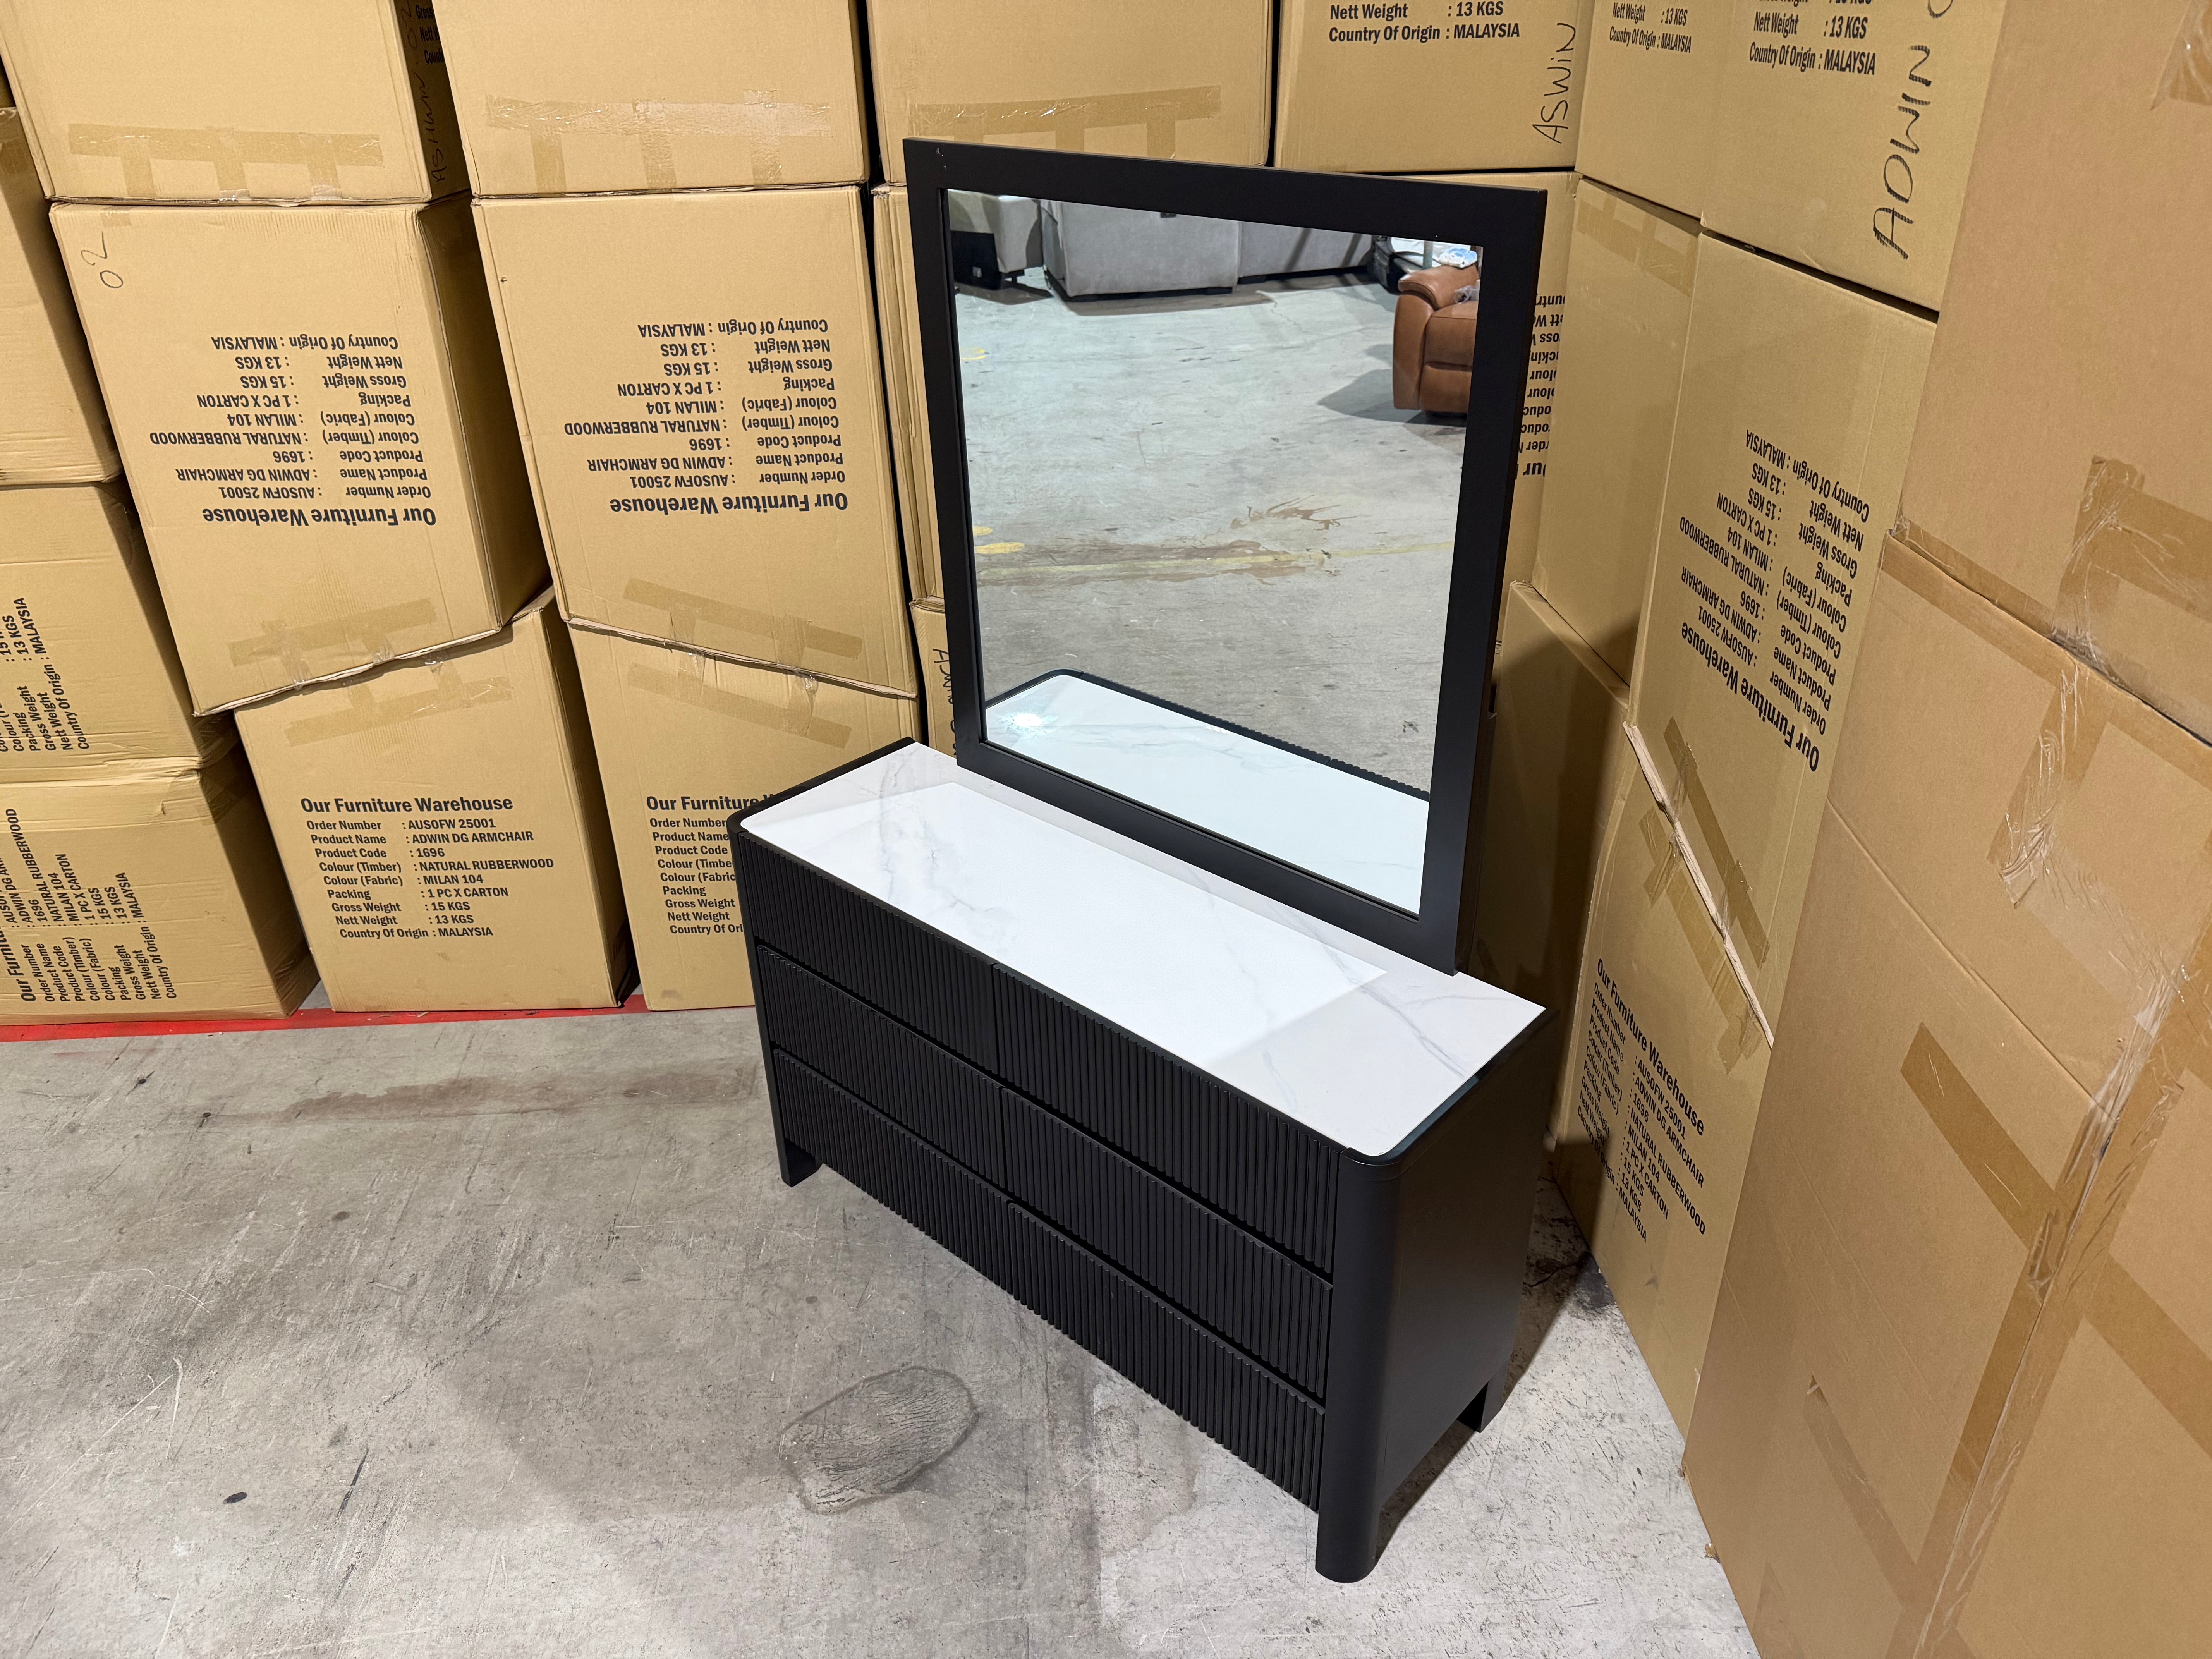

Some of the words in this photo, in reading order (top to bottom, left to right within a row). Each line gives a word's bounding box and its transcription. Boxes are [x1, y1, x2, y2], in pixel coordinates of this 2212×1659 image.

[1330, 5, 1359, 20] Nett
[1362, 3, 1408, 22] Weight
[1456, 2, 1473, 17] 13
[1476, 0, 1504, 16] KGS
[1753, 11, 1771, 32] Nett
[1771, 12, 1799, 39] Weight
[1829, 15, 1844, 38] 13
[1844, 16, 1868, 40] KGS
[1329, 27, 1381, 44] Country
[1384, 25, 1400, 41] Of
[1401, 25, 1440, 43] Origin
[1453, 23, 1520, 39] MALAYSIA
[1609, 26, 1632, 47] Country
[1632, 28, 1640, 45] Of
[1639, 29, 1656, 50] Origin
[1660, 33, 1692, 53] MALAYSIA
[1749, 41, 1779, 69] Country
[1779, 45, 1790, 65] Of
[1790, 45, 1816, 73] Origin
[1823, 48, 1876, 76] MALAYSIA
[1532, 23, 1577, 144] ASWIN
[81, 232, 124, 290] 02
[211, 337, 278, 350] MALAYSIA
[289, 334, 328, 350] Origin
[331, 337, 345, 350] Of
[348, 334, 398, 350] Country
[754, 338, 801, 354] Weight
[802, 339, 831, 352] Nett
[660, 343, 688, 357] KGS
[691, 343, 708, 356] 13
[240, 376, 268, 389] KGS
[270, 376, 287, 388] 15
[322, 373, 369, 388] Weight
[369, 375, 407, 388] Gross
[705, 381, 713, 394] 1
[782, 376, 835, 392] Packing
[617, 383, 670, 397] CARTON
[672, 382, 682, 395] X
[684, 382, 702, 395] PC
[227, 414, 252, 426] 104
[254, 414, 297, 426] MILAN
[320, 411, 371, 426] (Fabric)
[374, 413, 415, 426] Colour
[742, 414, 795, 431] (Timber)
[798, 416, 839, 429] Colour
[564, 421, 658, 435] RUBBERWOOD
[660, 419, 720, 433] NATURAL
[339, 450, 371, 463] Code
[373, 450, 424, 462] Product
[1746, 429, 1786, 470] MALAYSIA
[273, 451, 306, 463] 1696
[660, 457, 680, 470] DG
[682, 456, 725, 469] ADWIN
[756, 454, 792, 467] Name
[794, 452, 843, 466] Product
[587, 458, 657, 471] ARMCHAIR
[1793, 459, 1819, 491] Origin
[218, 487, 260, 499] 25001
[263, 487, 314, 499] AUSOFW
[346, 486, 395, 499] Number
[397, 486, 431, 498] Order
[1818, 477, 1831, 498] Of
[610, 497, 719, 515] Warehouse
[722, 494, 810, 513] Furniture
[814, 493, 848, 510] Our
[1831, 481, 1869, 523] Country
[202, 508, 309, 526] Warehouse
[311, 508, 399, 526] Furniture
[403, 508, 436, 526] Our
[1681, 566, 1719, 609] ARMCHAIR
[1719, 598, 1731, 621] DG
[14, 598, 47, 654] MALAYSIA
[1731, 609, 1757, 643] ADWIN
[1681, 622, 1738, 694] Warehouse
[1774, 647, 1797, 680] Name
[44, 664, 64, 696] Origin
[1797, 667, 1831, 711] Product
[56, 697, 71, 709] Of
[1741, 678, 1795, 749] Furniture
[67, 712, 89, 749] Country
[1795, 732, 1819, 772] Our
[301, 798, 331, 812] Our
[334, 798, 412, 812] Furniture
[414, 797, 513, 812] Warehouse
[646, 796, 677, 810] Our
[307, 820, 337, 830] Order
[338, 820, 381, 830] Number
[409, 819, 455, 830] AUSOFW
[458, 818, 496, 829] 25001
[650, 818, 680, 828] Order
[683, 818, 726, 828] Number
[310, 834, 354, 844] Product
[355, 834, 386, 844] Name
[412, 833, 450, 844] ADWIN
[452, 833, 469, 843] DG
[472, 831, 534, 842] ARMCHAIR
[653, 832, 696, 841] Product
[698, 832, 730, 841] Name
[5, 809, 44, 879] RUBBERWOOD
[655, 845, 697, 855] Product
[700, 846, 728, 855] Code
[314, 848, 358, 858] Product
[359, 848, 387, 858] Code
[416, 848, 445, 857] 1696
[319, 862, 354, 871] Colour
[357, 862, 402, 874] (Timber)
[419, 861, 471, 871] NATURAL
[472, 858, 554, 870] RUBBERWOOD
[323, 876, 358, 885] Colour
[361, 875, 403, 887] (Fabric)
[423, 875, 459, 884] MILAN
[462, 874, 484, 884] 104
[115, 872, 144, 918] MALAYSIA
[327, 889, 371, 900] Packing
[428, 889, 435, 898] 1
[436, 888, 452, 898] PC
[453, 888, 462, 897] X
[463, 887, 509, 897] CARTON
[663, 886, 706, 896] Packing
[36, 881, 64, 922] NATURAL
[331, 903, 362, 912] Gross
[362, 902, 402, 914] Weight
[431, 902, 445, 911] 15
[447, 901, 471, 911] KGS
[665, 899, 696, 908] Gross
[697, 898, 735, 909] Weight
[668, 912, 690, 921] Nett
[692, 911, 730, 922] Weight
[340, 929, 380, 939] Country
[383, 928, 395, 938] Of
[397, 928, 429, 939] Origin
[438, 927, 494, 937] MALAYSIA
[670, 925, 711, 935] Country
[714, 924, 726, 933] Of
[140, 927, 158, 952] Origin
[62, 937, 89, 972] (Timber)
[149, 954, 163, 964] Of
[81, 974, 100, 1001] Colour
[156, 965, 177, 998] Country
[1597, 958, 1610, 990] Our
[1611, 980, 1647, 1052] Furniture
[1649, 1041, 1704, 1136] Warehouse
[1594, 982, 1607, 1011] Order
[1607, 1005, 1626, 1044] Number
[1637, 1059, 1665, 1105] AUSOFW
[1664, 1099, 1686, 1140] 25001
